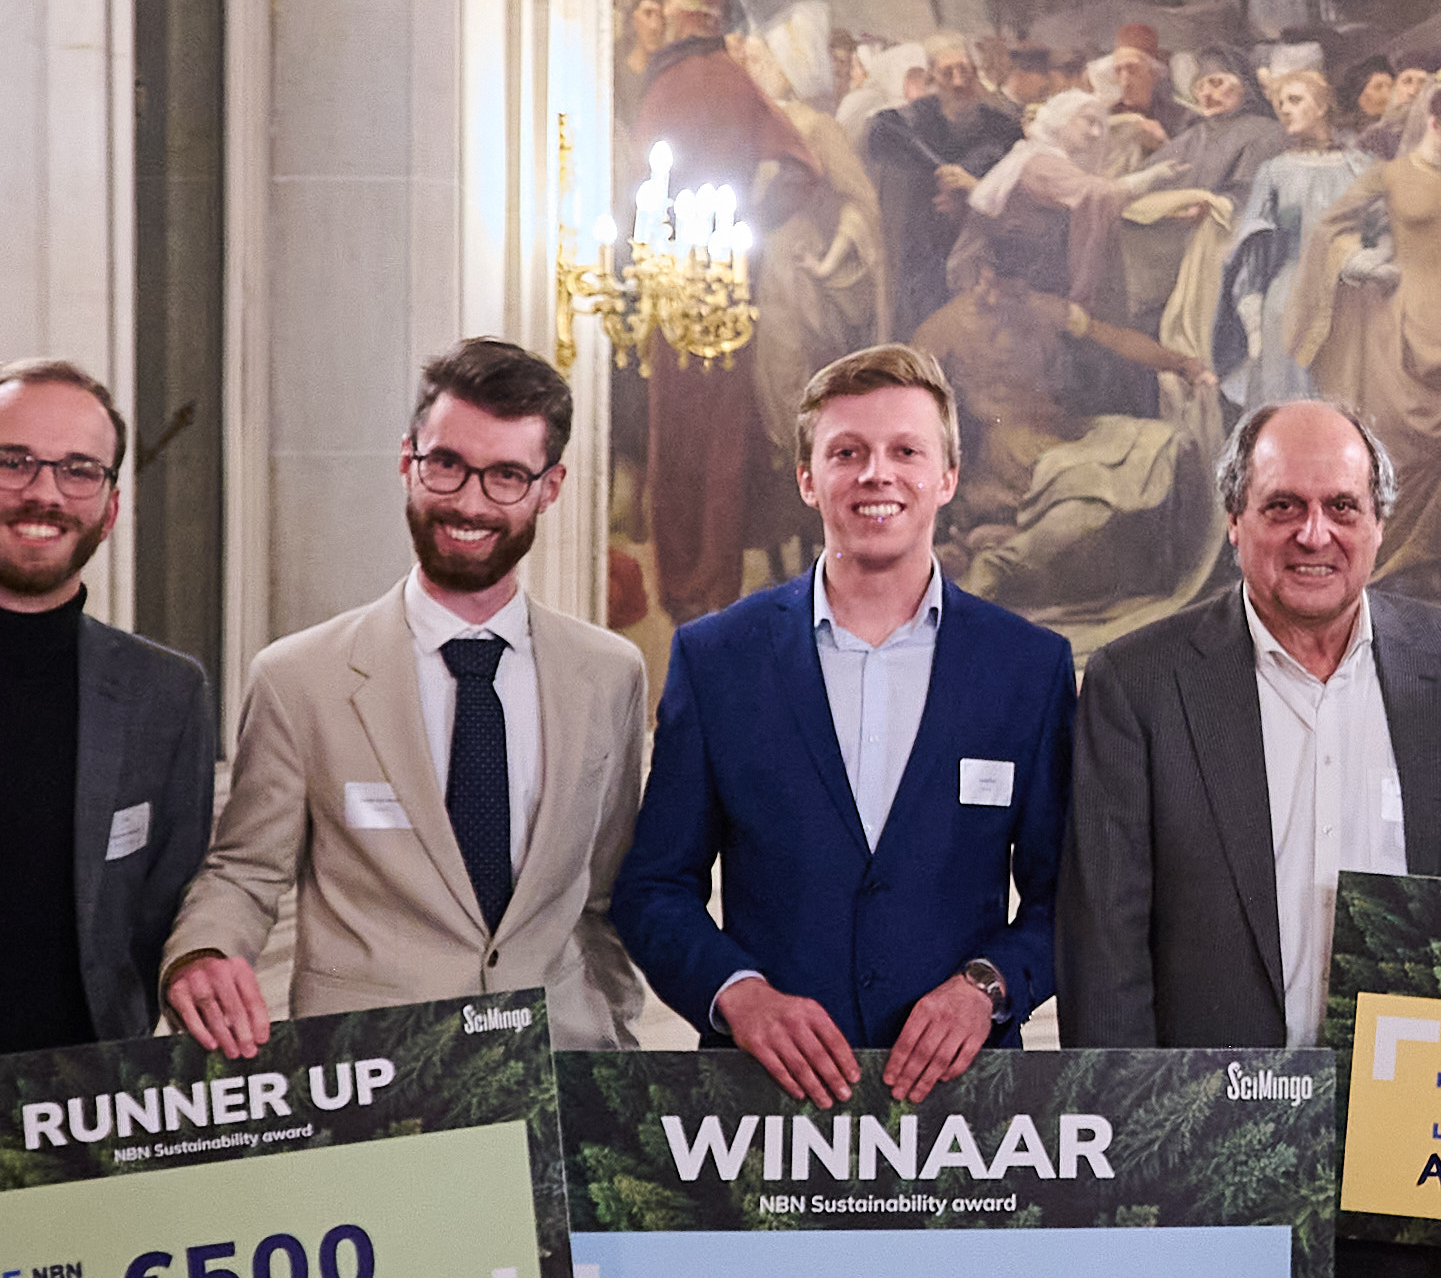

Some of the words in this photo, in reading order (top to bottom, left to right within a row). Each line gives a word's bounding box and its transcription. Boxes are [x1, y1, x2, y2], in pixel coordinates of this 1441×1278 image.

[463, 1004, 532, 1034] SciMingo
[22, 1072, 288, 1150] RUNNER
[310, 1058, 396, 1110] UP
[1227, 1063, 1313, 1106] SciMingo
[114, 1146, 151, 1162] NBN
[154, 1130, 259, 1160] Sustainability
[262, 1124, 312, 1144] award
[662, 1113, 1114, 1182] WINNAAR
[760, 1195, 806, 1213] NBN
[810, 1193, 948, 1217] Sustainability
[952, 1193, 1016, 1214] award
